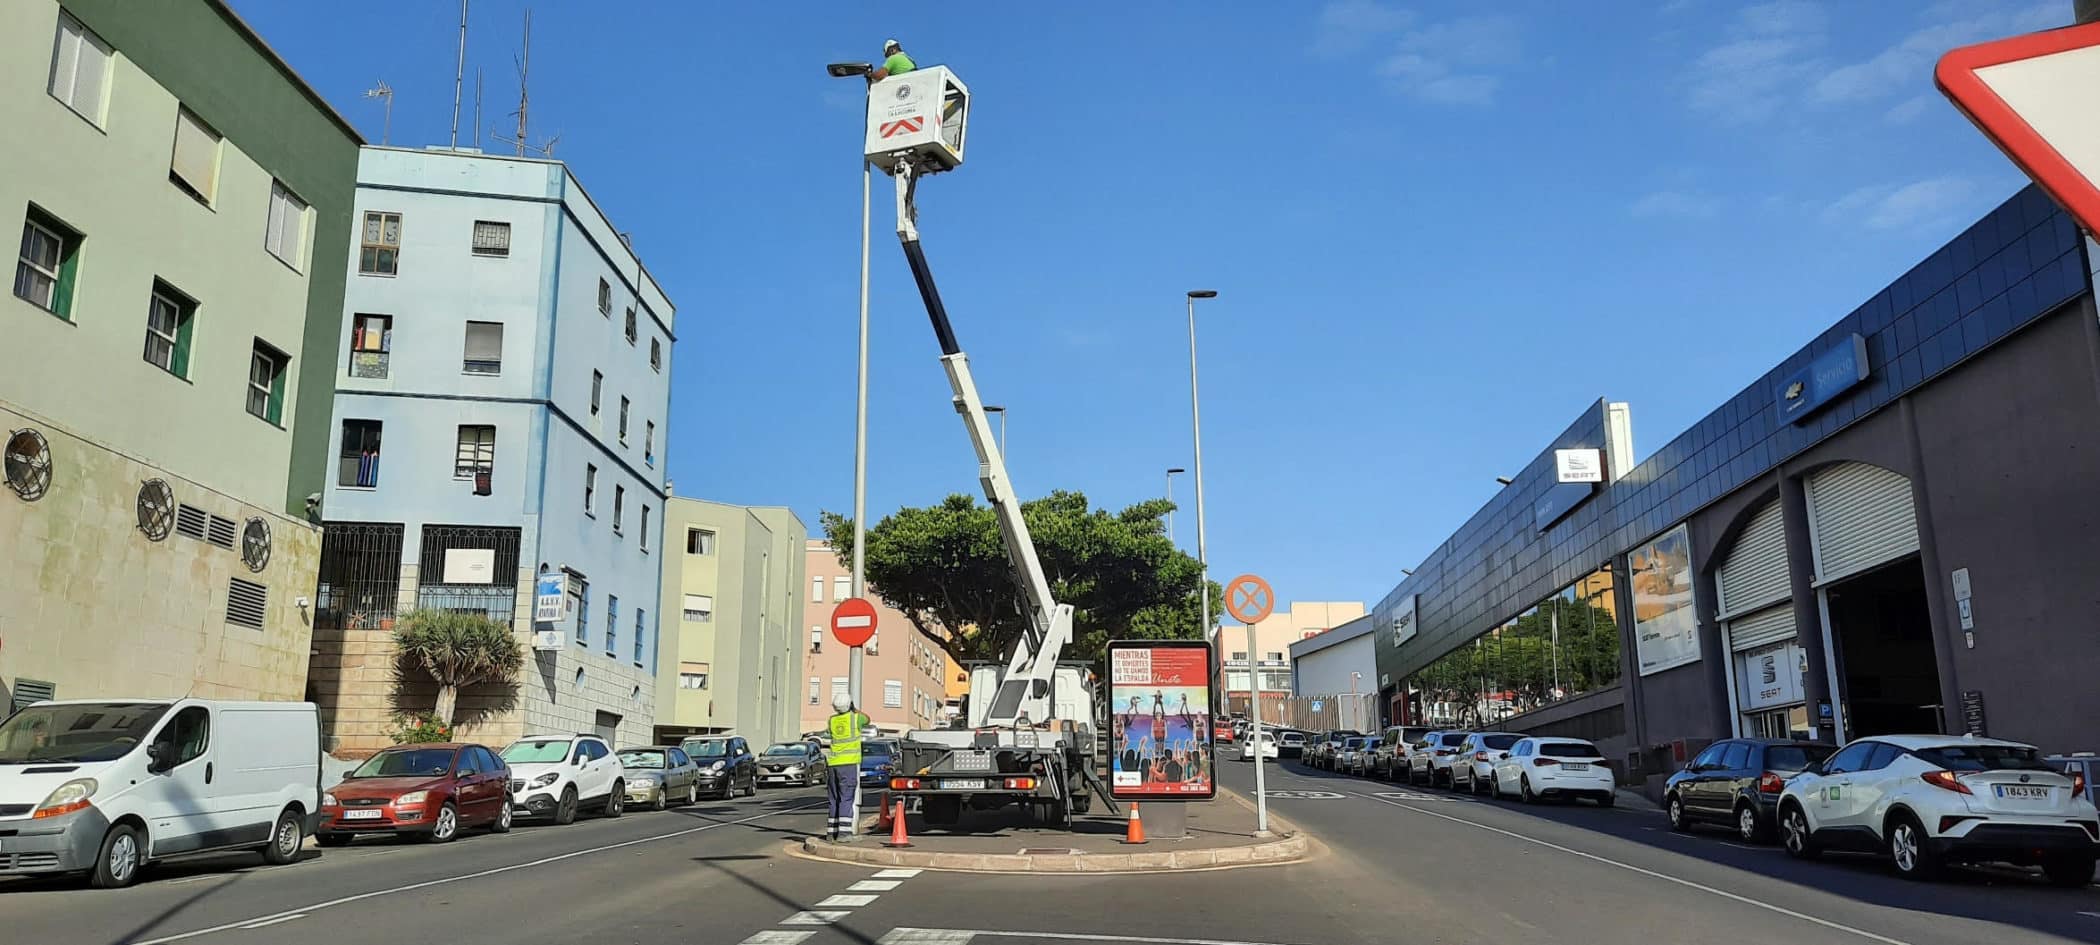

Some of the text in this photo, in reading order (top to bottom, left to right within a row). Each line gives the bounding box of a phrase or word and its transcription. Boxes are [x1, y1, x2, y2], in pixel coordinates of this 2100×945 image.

[1114, 650, 1149, 659] MIENTRAS
[1760, 687, 1781, 699] SEAT
[2005, 787, 2048, 797] 1843 KRV
